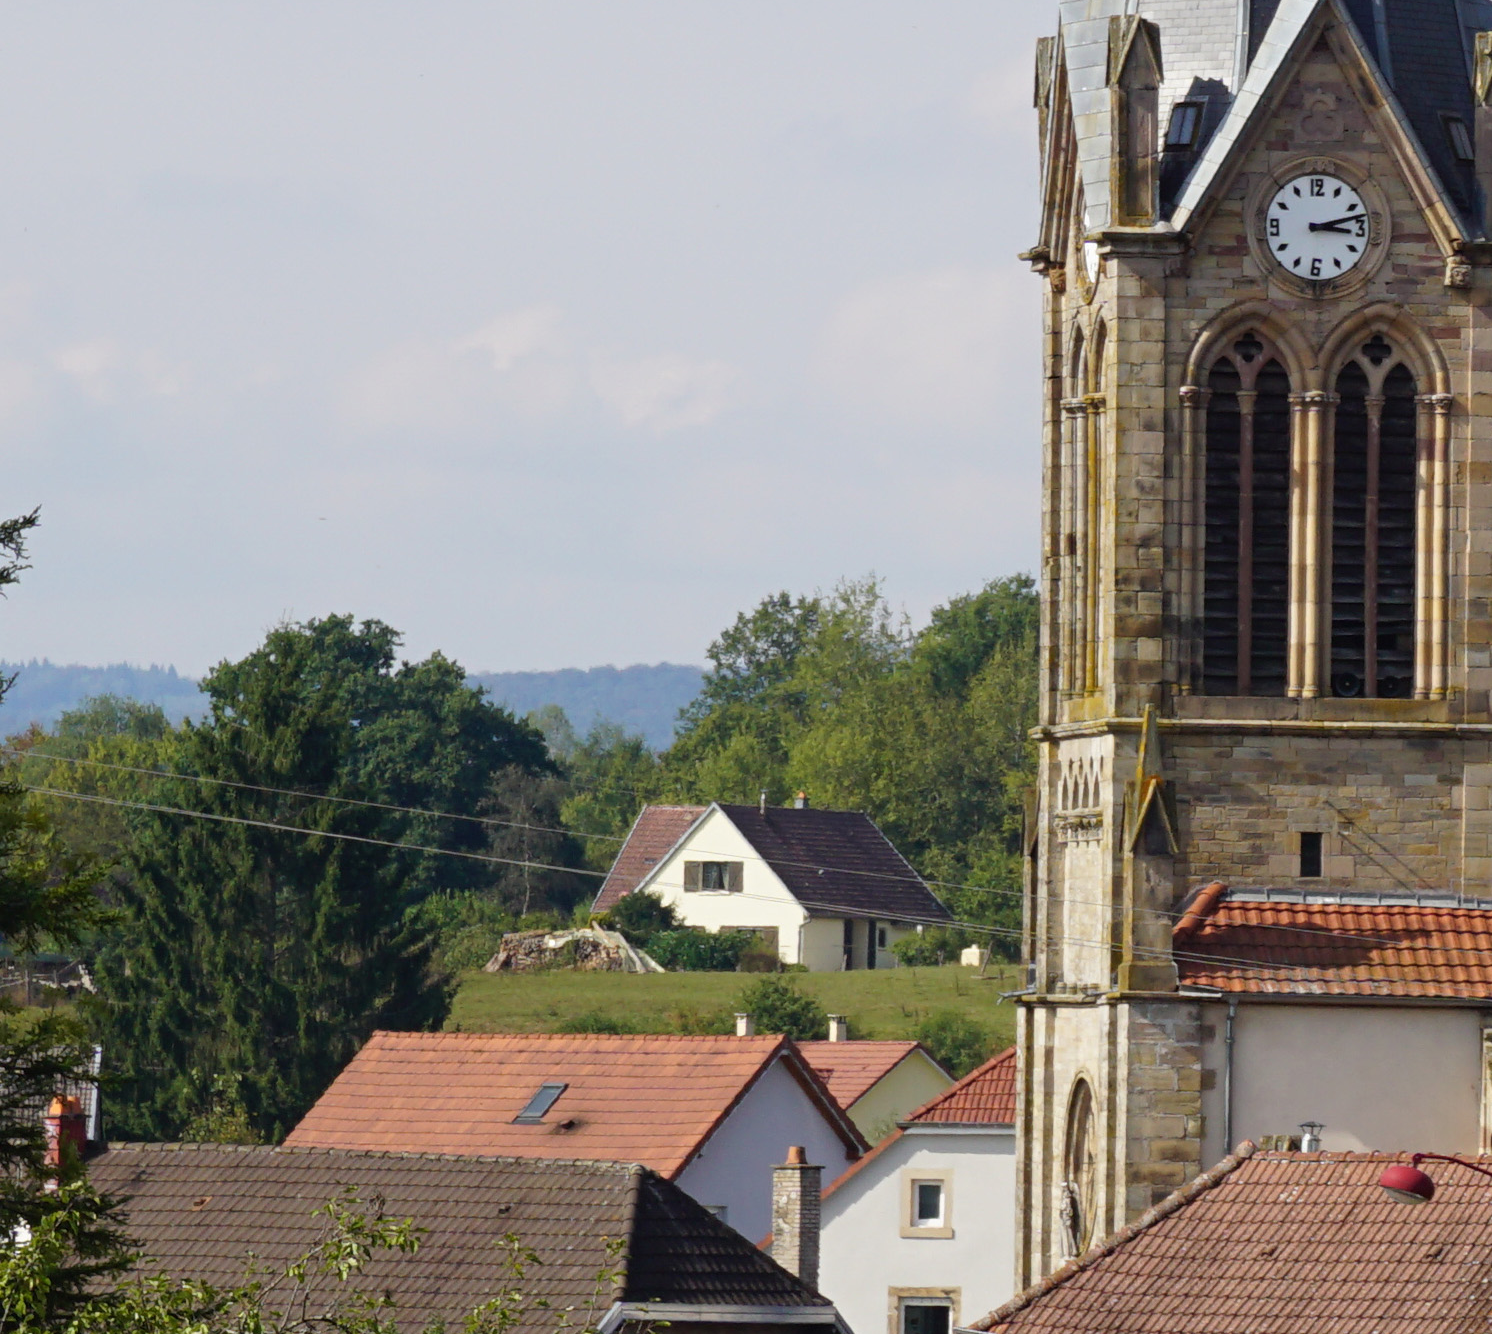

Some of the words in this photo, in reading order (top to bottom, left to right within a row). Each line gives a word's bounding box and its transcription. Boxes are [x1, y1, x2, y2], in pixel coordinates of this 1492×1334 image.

[1310, 178, 1325, 197] 12
[1269, 218, 1280, 237] 9
[1355, 219, 1366, 237] 3
[1310, 258, 1322, 277] 6
